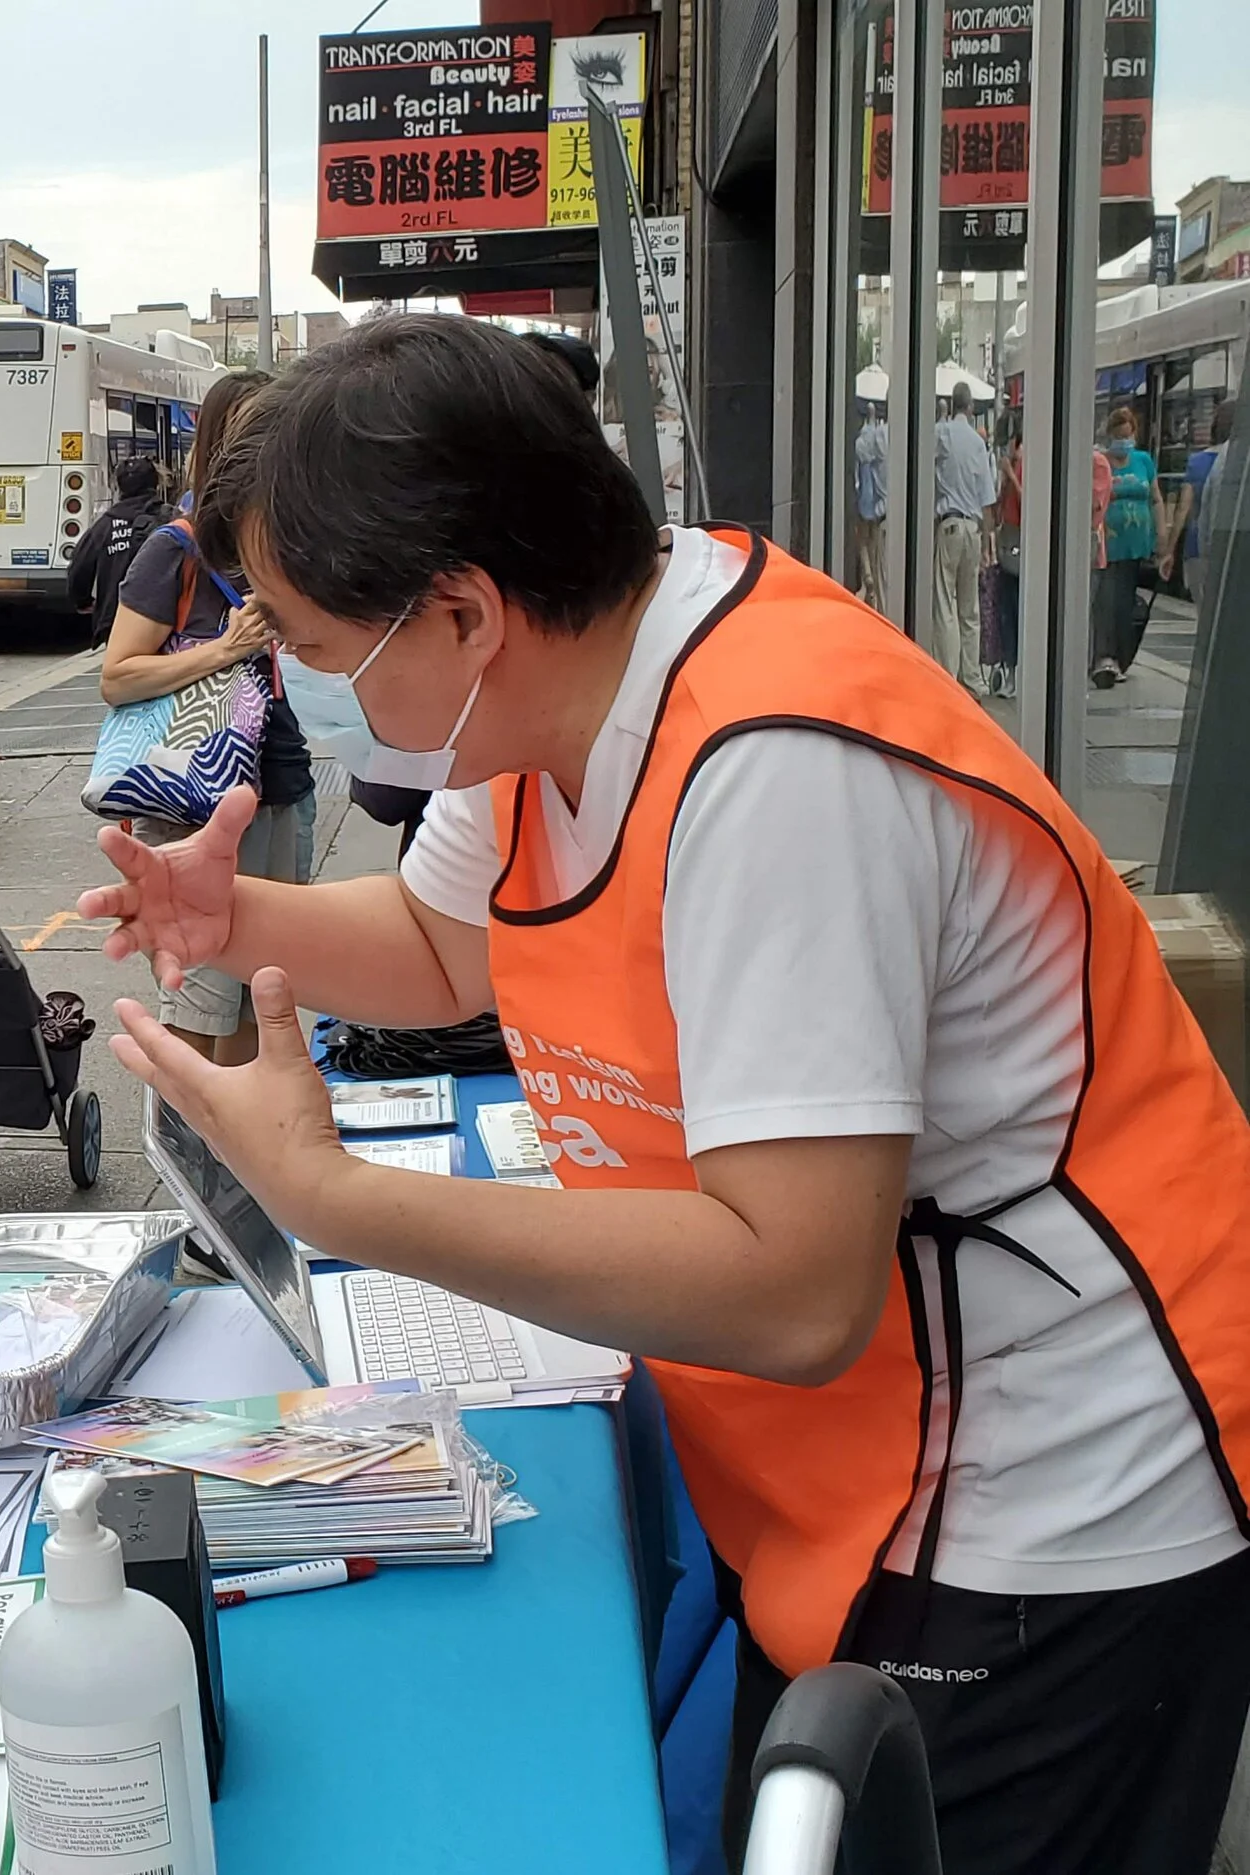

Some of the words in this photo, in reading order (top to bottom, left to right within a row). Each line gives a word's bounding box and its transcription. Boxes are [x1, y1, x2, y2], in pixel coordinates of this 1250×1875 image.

[325, 35, 511, 68] TRANSFORMATION
[513, 35, 537, 85] 美姿
[430, 64, 511, 87] Beauty
[328, 96, 377, 123] nail
[394, 92, 470, 119] facial
[487, 89, 544, 115] hair
[552, 109, 589, 122] Eyelashe
[403, 120, 435, 139] 3rd
[439, 118, 463, 136] FL
[324, 147, 543, 207] 電腦維修
[550, 187, 596, 203] 917-96
[401, 211, 431, 229] 2rd
[436, 210, 459, 227] FL
[54, 285, 71, 325] 法拉
[6, 369, 49, 385] 7387
[947, 1668, 989, 1683] neo
